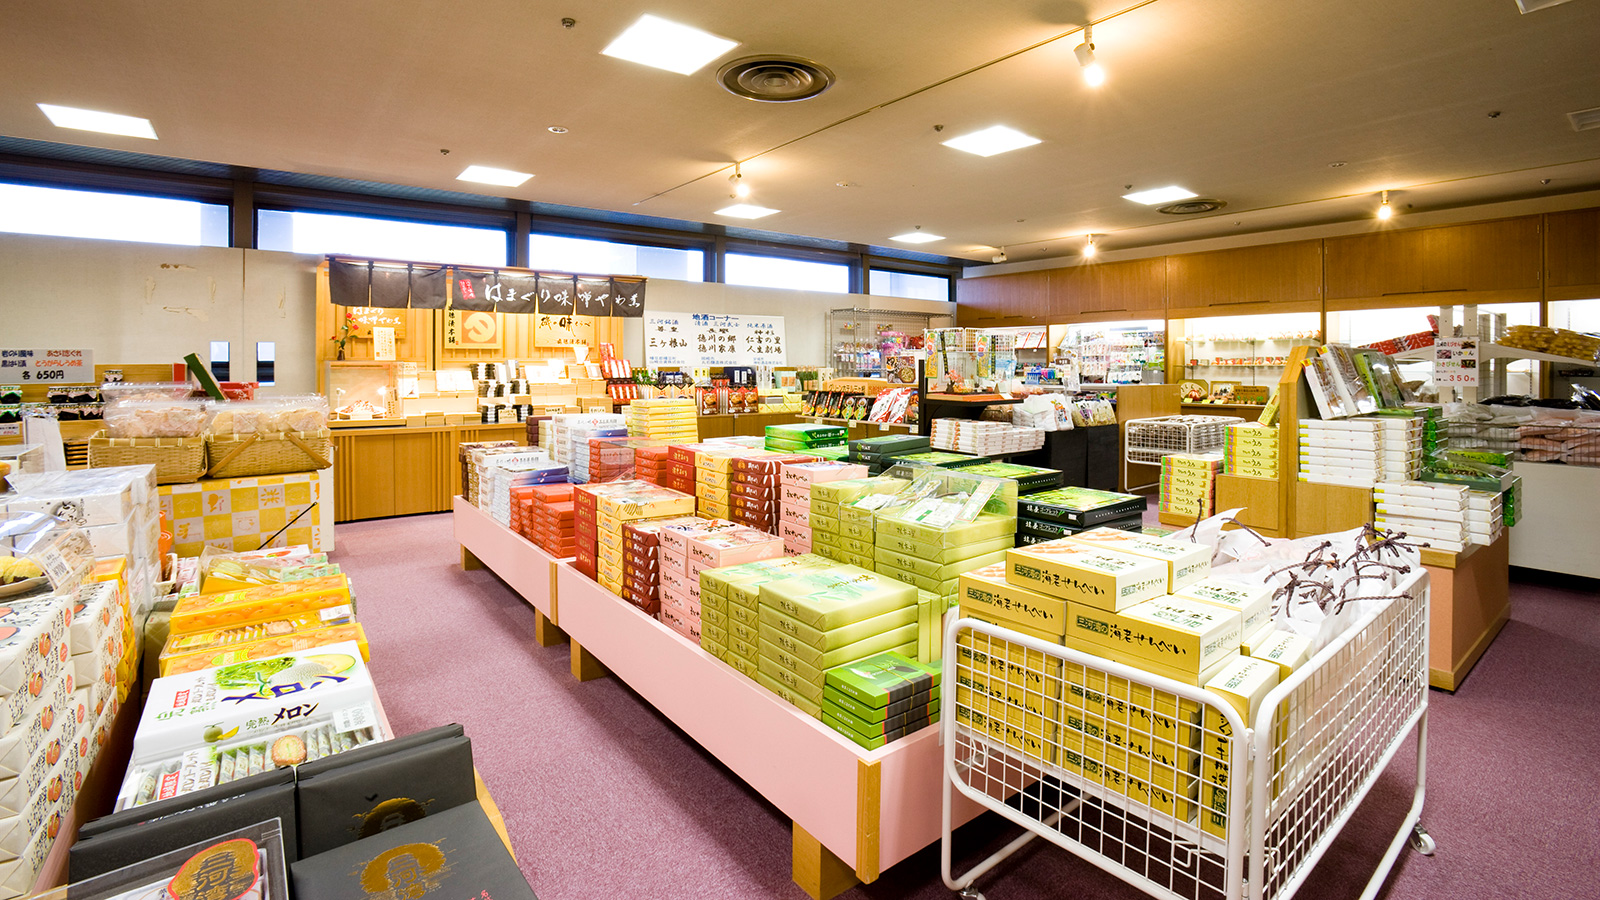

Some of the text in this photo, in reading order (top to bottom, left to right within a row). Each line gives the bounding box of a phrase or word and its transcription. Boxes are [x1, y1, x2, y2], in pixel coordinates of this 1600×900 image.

[692, 313, 740, 321] 地酒コーナー
[697, 333, 737, 343] 徳川の郷
[697, 343, 737, 353] 徳川家康
[746, 345, 783, 354] 人生劇場
[22, 370, 65, 380] 各 650円
[271, 702, 320, 726] メロン
